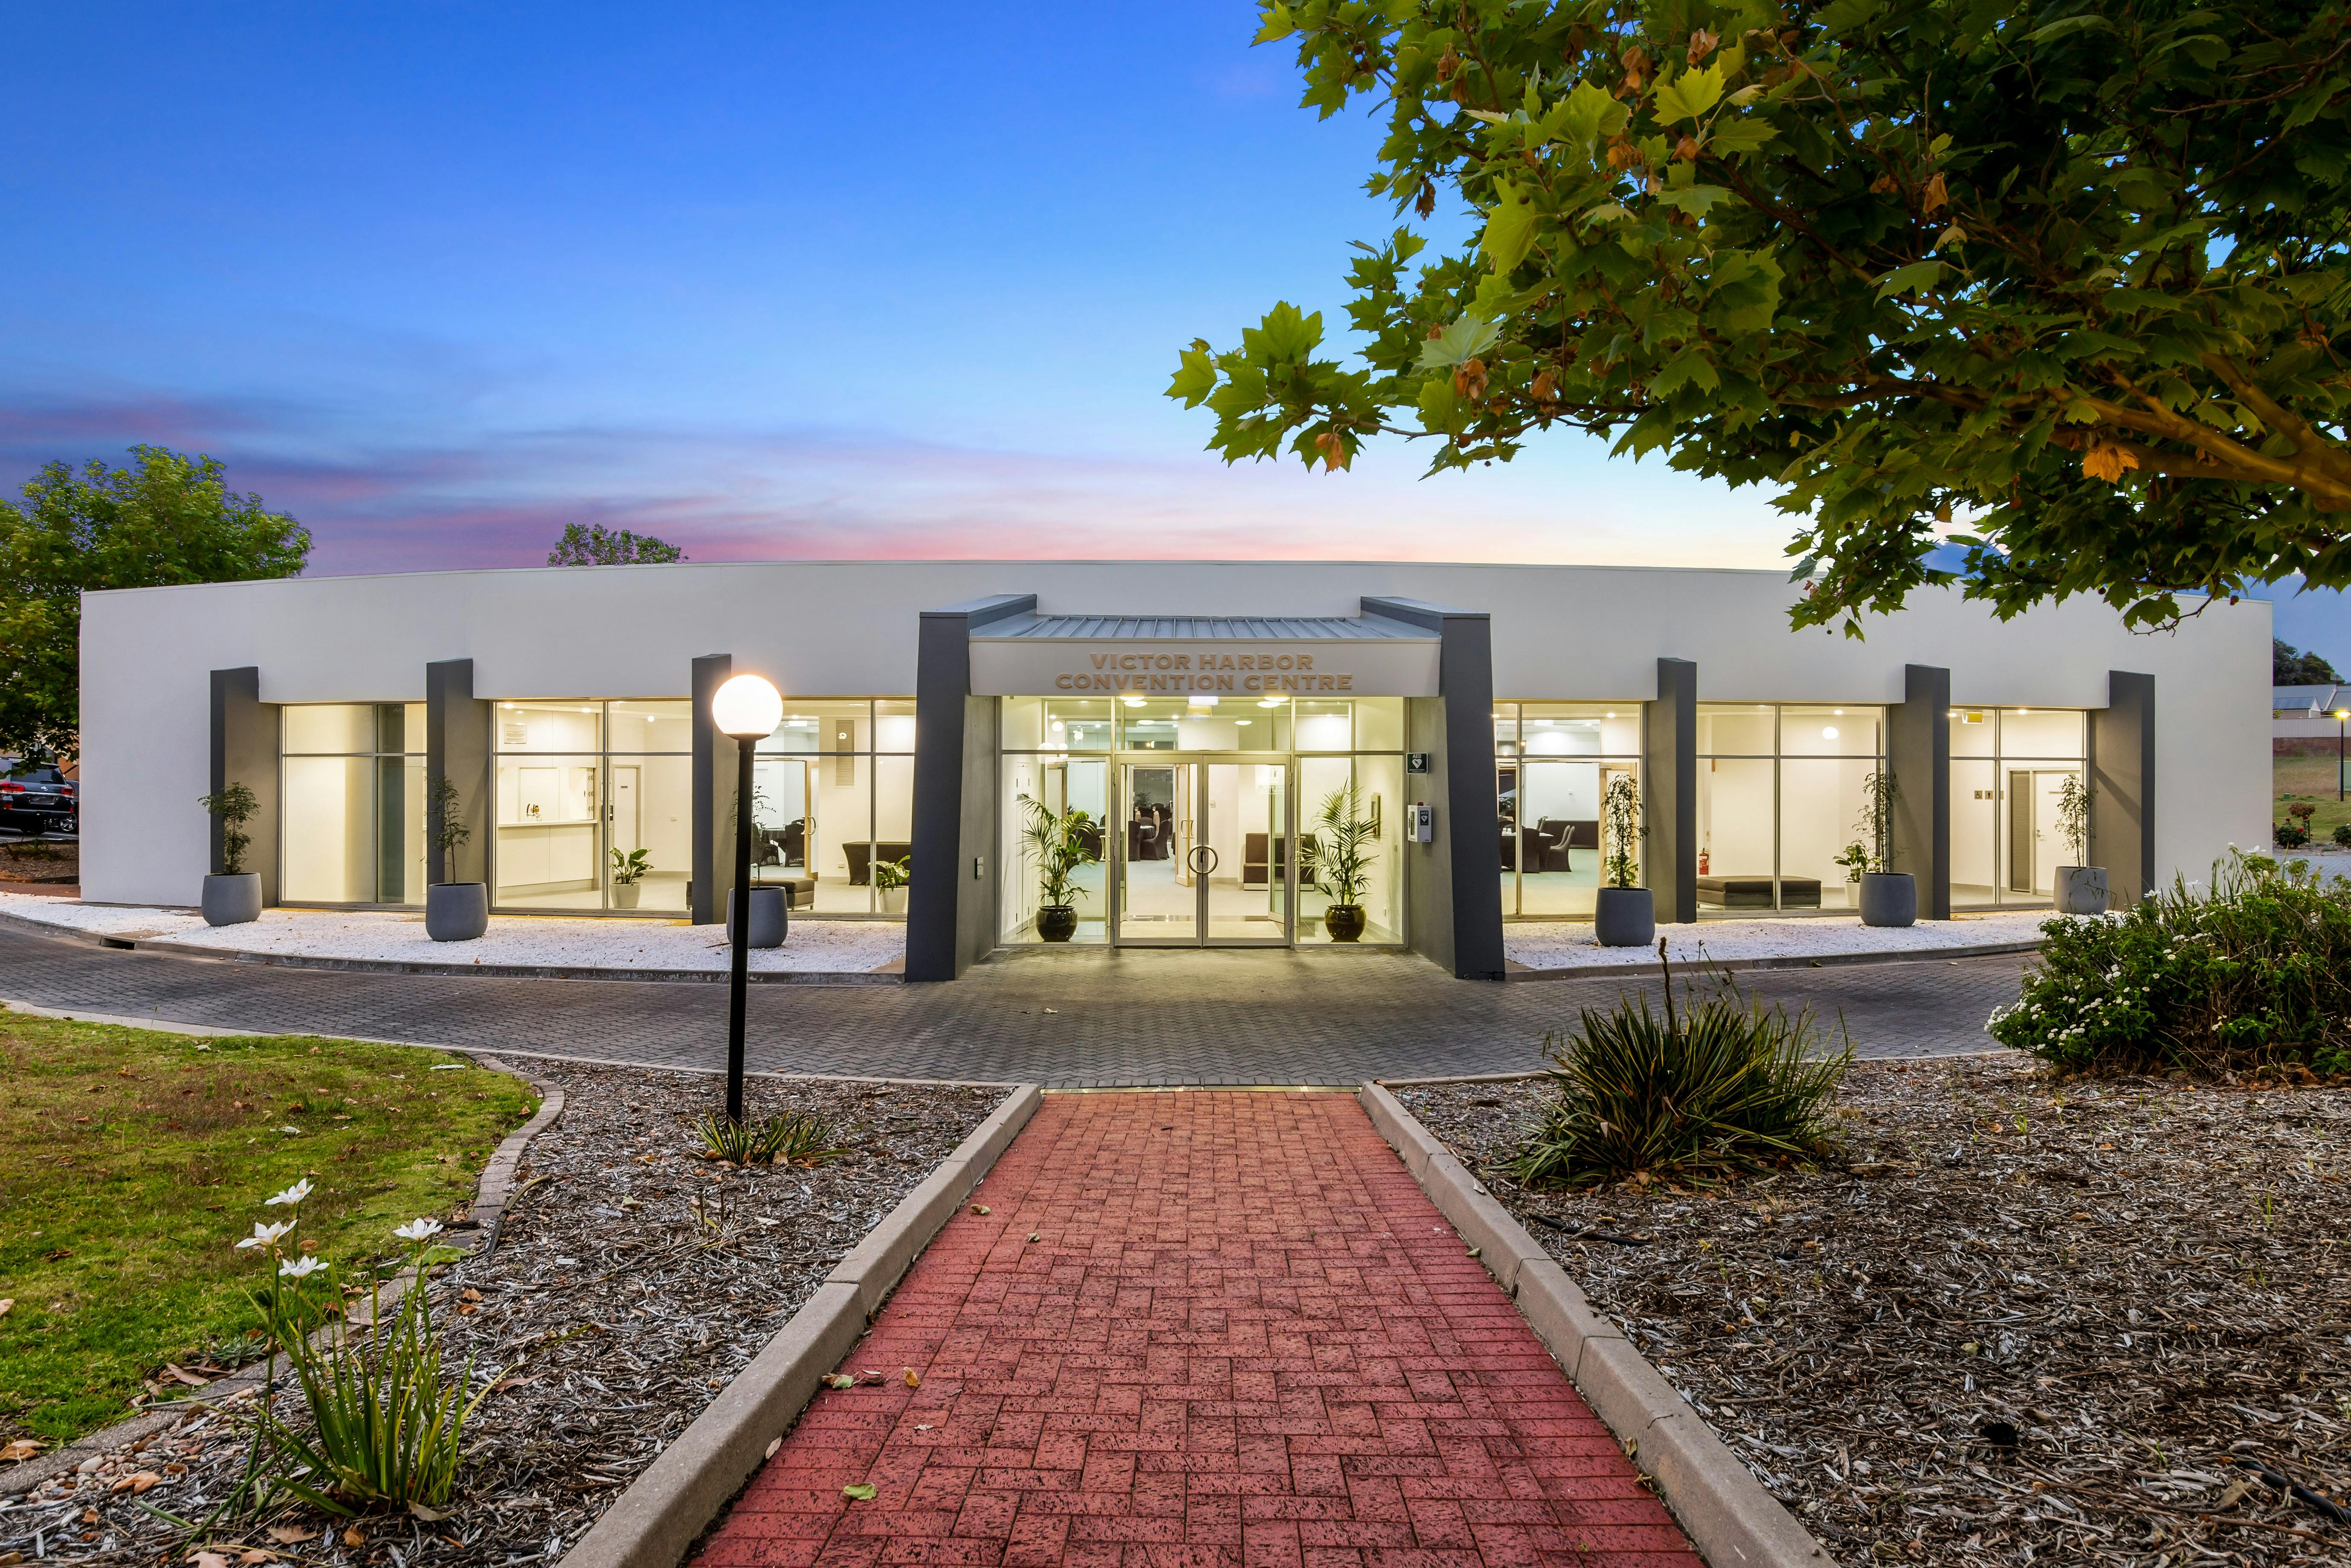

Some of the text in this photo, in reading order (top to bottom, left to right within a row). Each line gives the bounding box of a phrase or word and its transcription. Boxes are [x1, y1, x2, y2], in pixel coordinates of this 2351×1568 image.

[1090, 653, 1313, 670] VICTOR HARBOR
[1055, 673, 1352, 690] CONVENTION CENTRE
